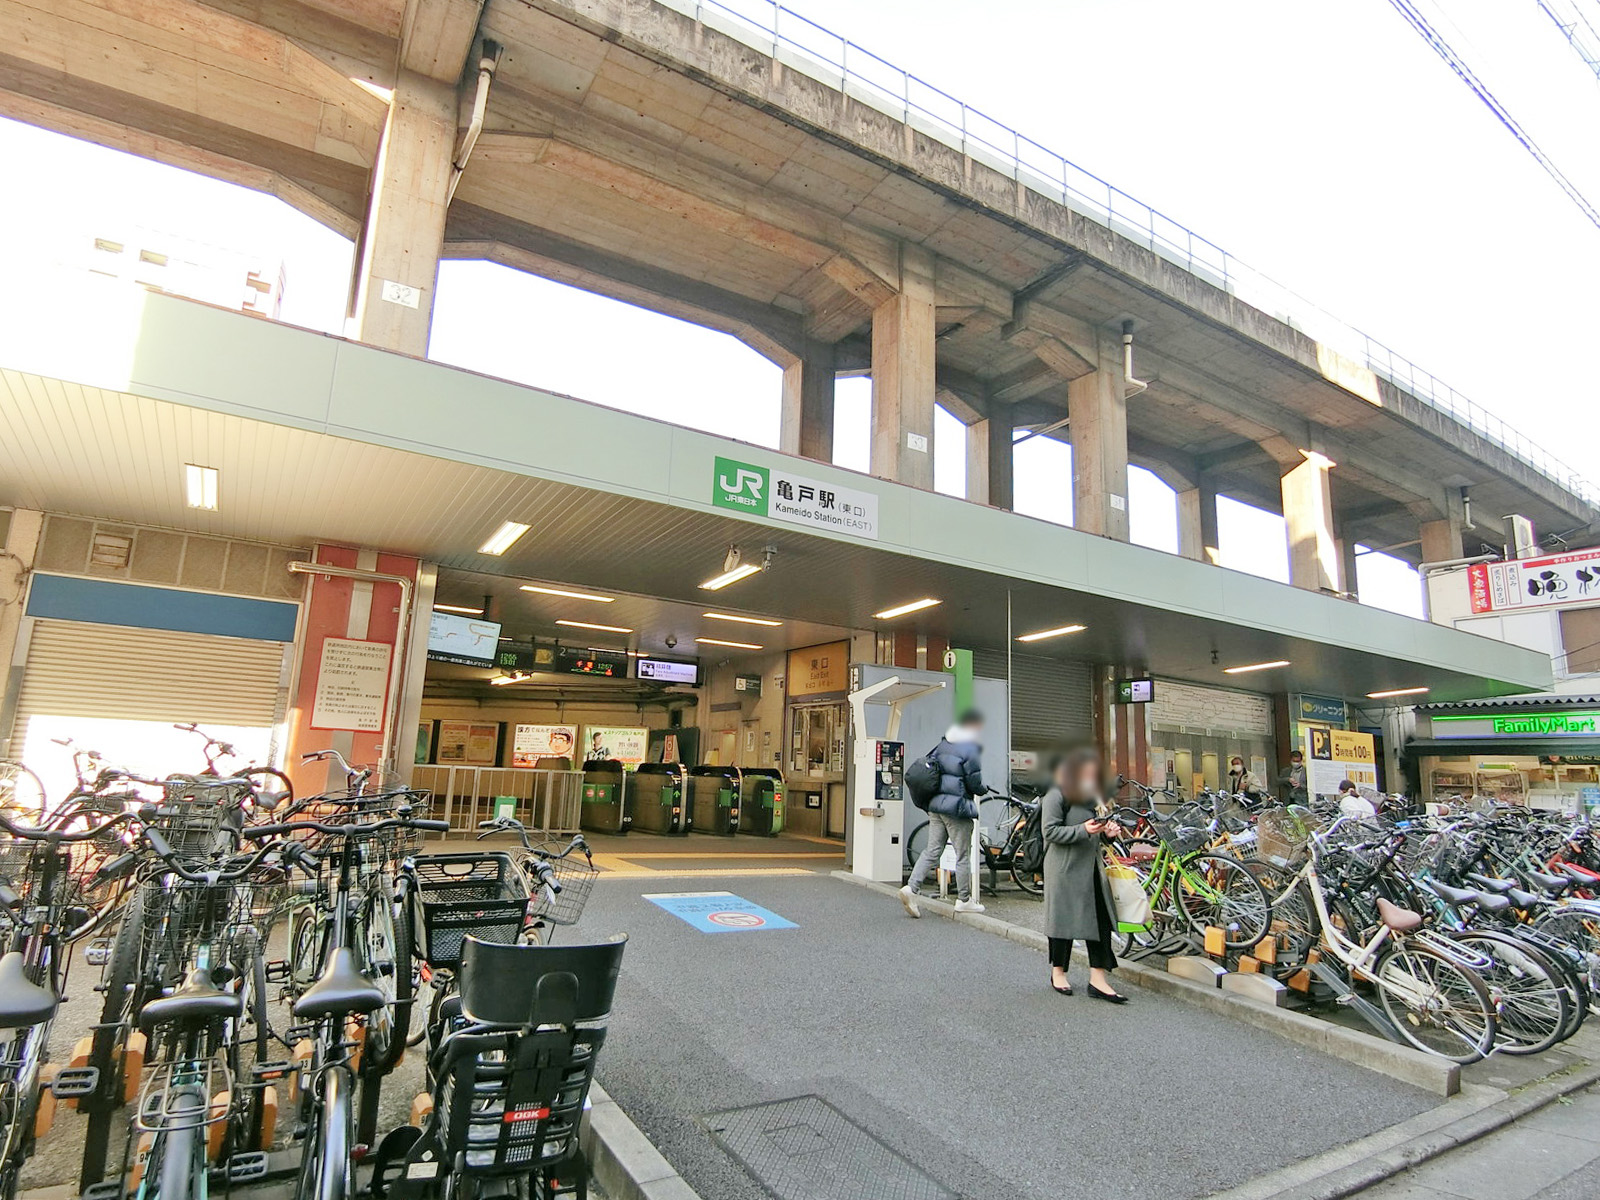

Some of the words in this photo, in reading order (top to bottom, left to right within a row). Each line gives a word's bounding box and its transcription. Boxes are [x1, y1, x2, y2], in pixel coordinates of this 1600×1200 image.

[720, 468, 763, 500] JR
[725, 494, 757, 507] JR東日本
[775, 502, 812, 518] Kameido
[811, 657, 829, 670] 東口
[1312, 705, 1344, 716] クリーニング
[1493, 716, 1596, 734] FamilyMart
[513, 1110, 540, 1120] OGK
